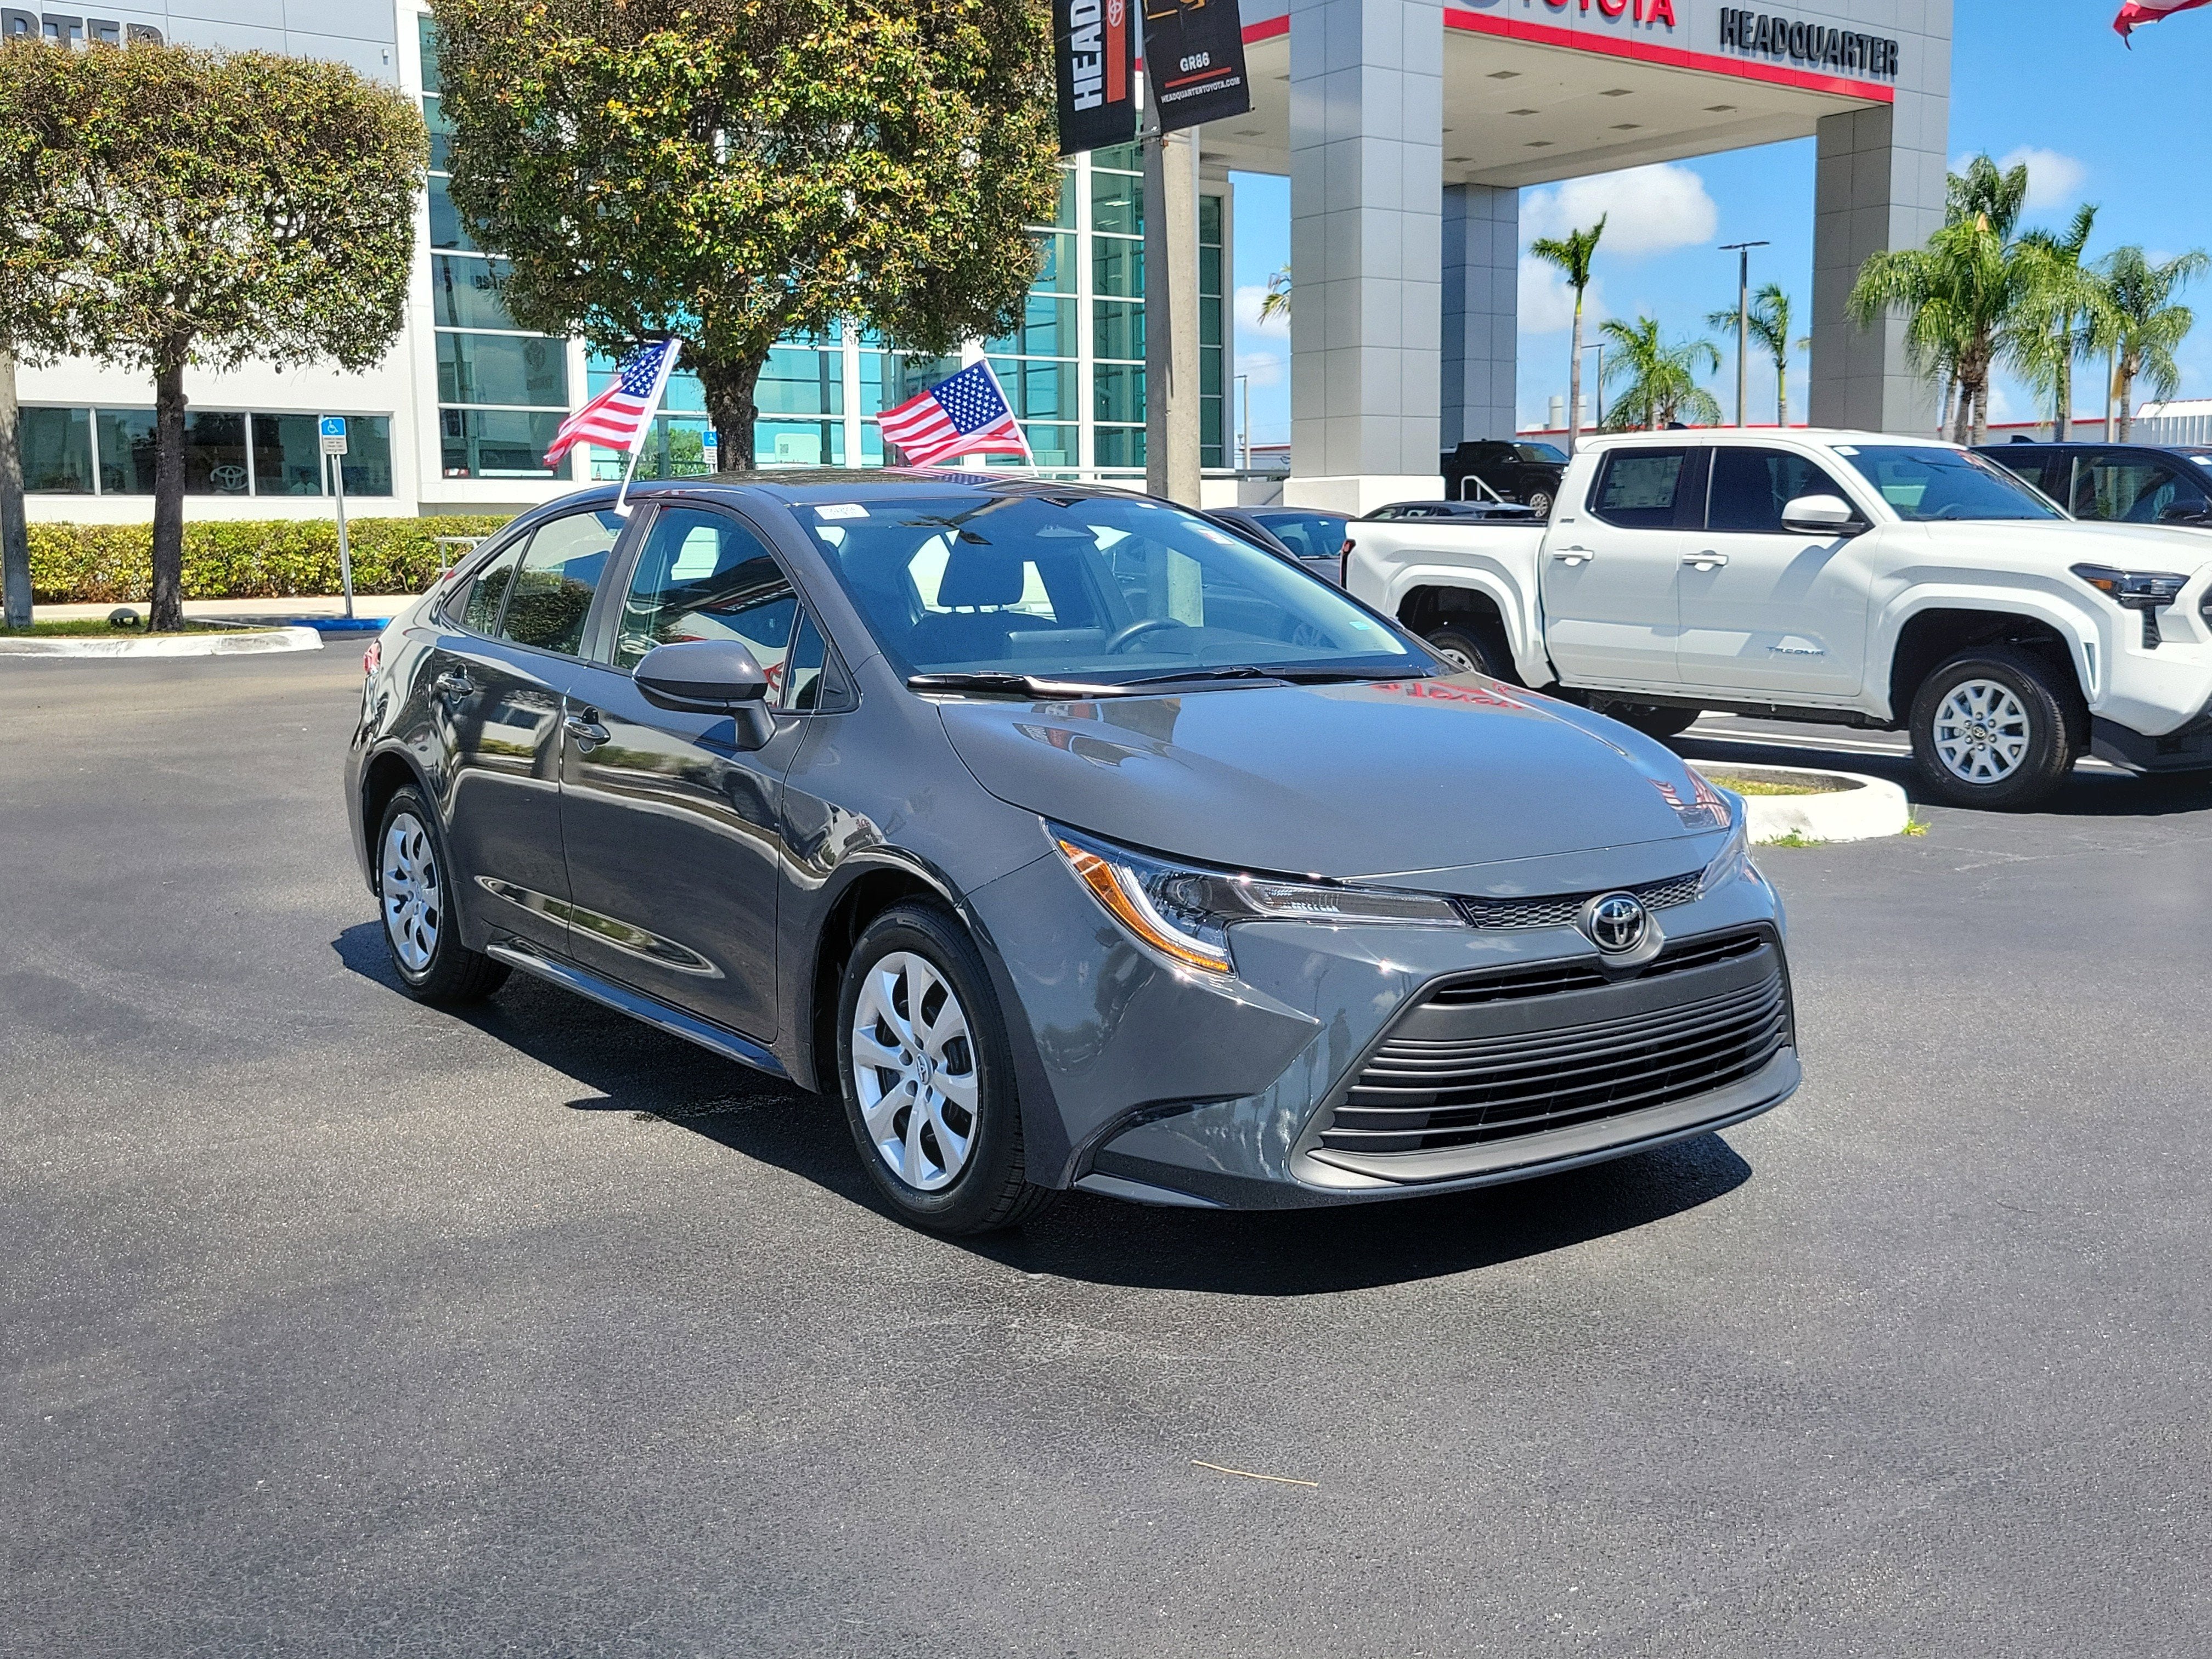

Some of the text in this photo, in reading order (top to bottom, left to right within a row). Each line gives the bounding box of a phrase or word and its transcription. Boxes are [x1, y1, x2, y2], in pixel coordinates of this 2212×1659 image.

[1720, 7, 1898, 75] HEADQUARTER
[1180, 52, 1210, 72] GR86
[1161, 77, 1240, 103] HEADQUARTERTOYOTA.COM
